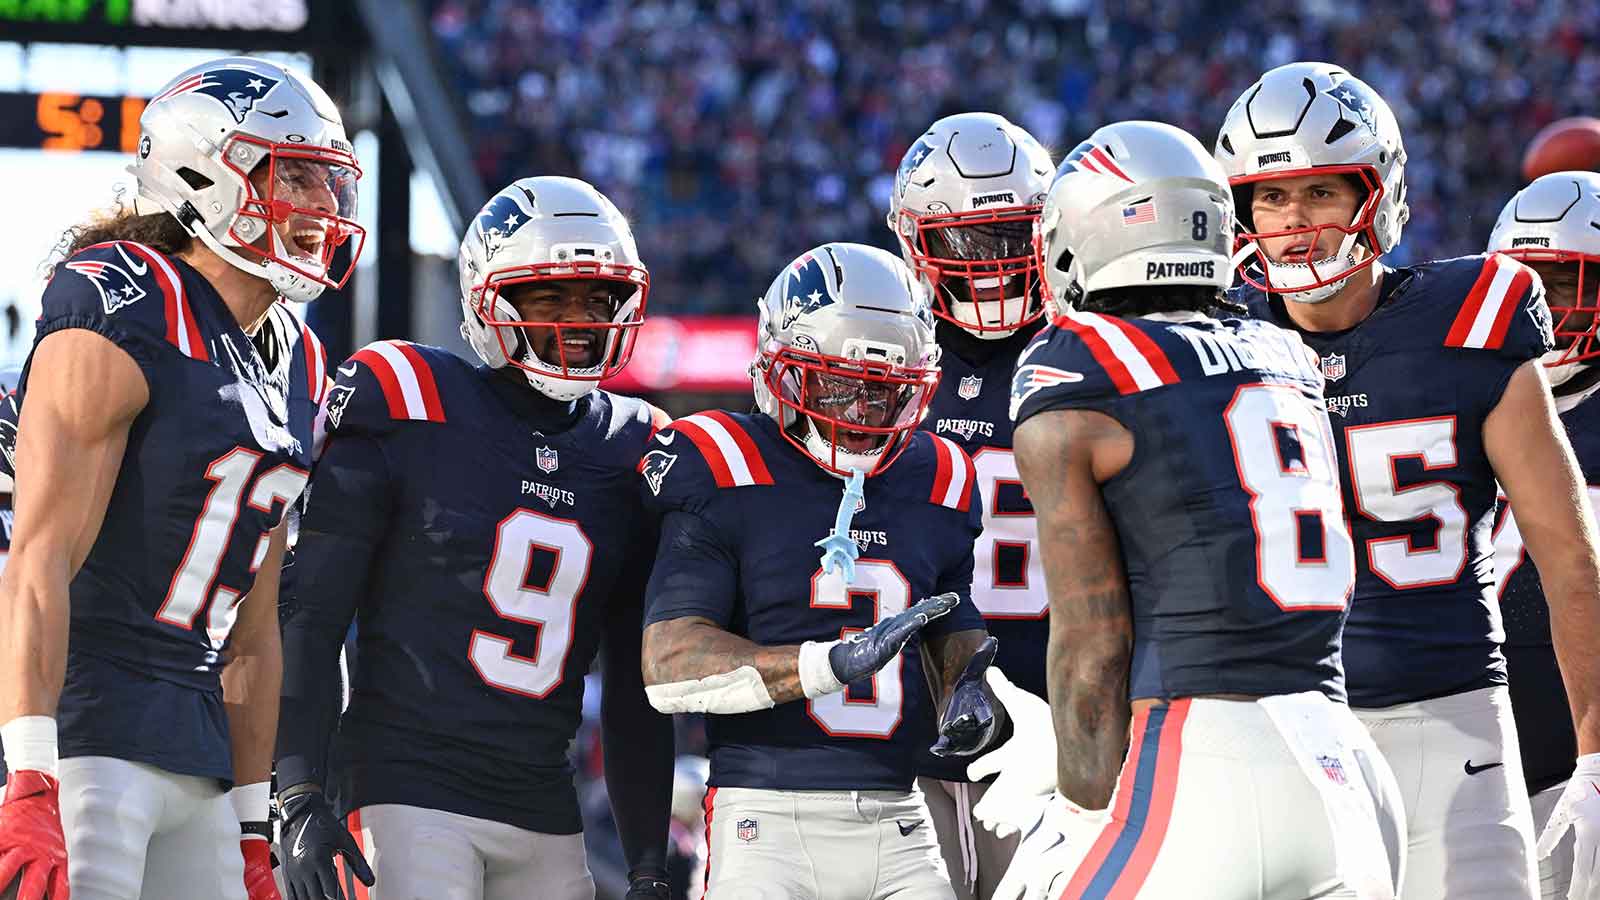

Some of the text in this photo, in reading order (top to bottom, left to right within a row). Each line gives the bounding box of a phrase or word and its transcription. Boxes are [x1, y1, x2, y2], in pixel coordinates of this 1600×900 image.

[1257, 151, 1291, 168] PATRIOTS
[972, 193, 1014, 208] PATRIOTS
[1192, 210, 1208, 241] 8
[1512, 237, 1550, 248] PATRIOTS
[1146, 260, 1215, 280] PATRIOTS
[1326, 365, 1343, 377] NFL
[1324, 393, 1368, 408] RIOTS
[936, 418, 995, 438] PATRIOTS
[521, 480, 575, 506] PATRIOTS
[1223, 382, 1356, 612] 8
[1344, 415, 1470, 590] 5
[154, 446, 311, 642] 13
[467, 507, 594, 700] 9
[807, 557, 912, 741] 3
